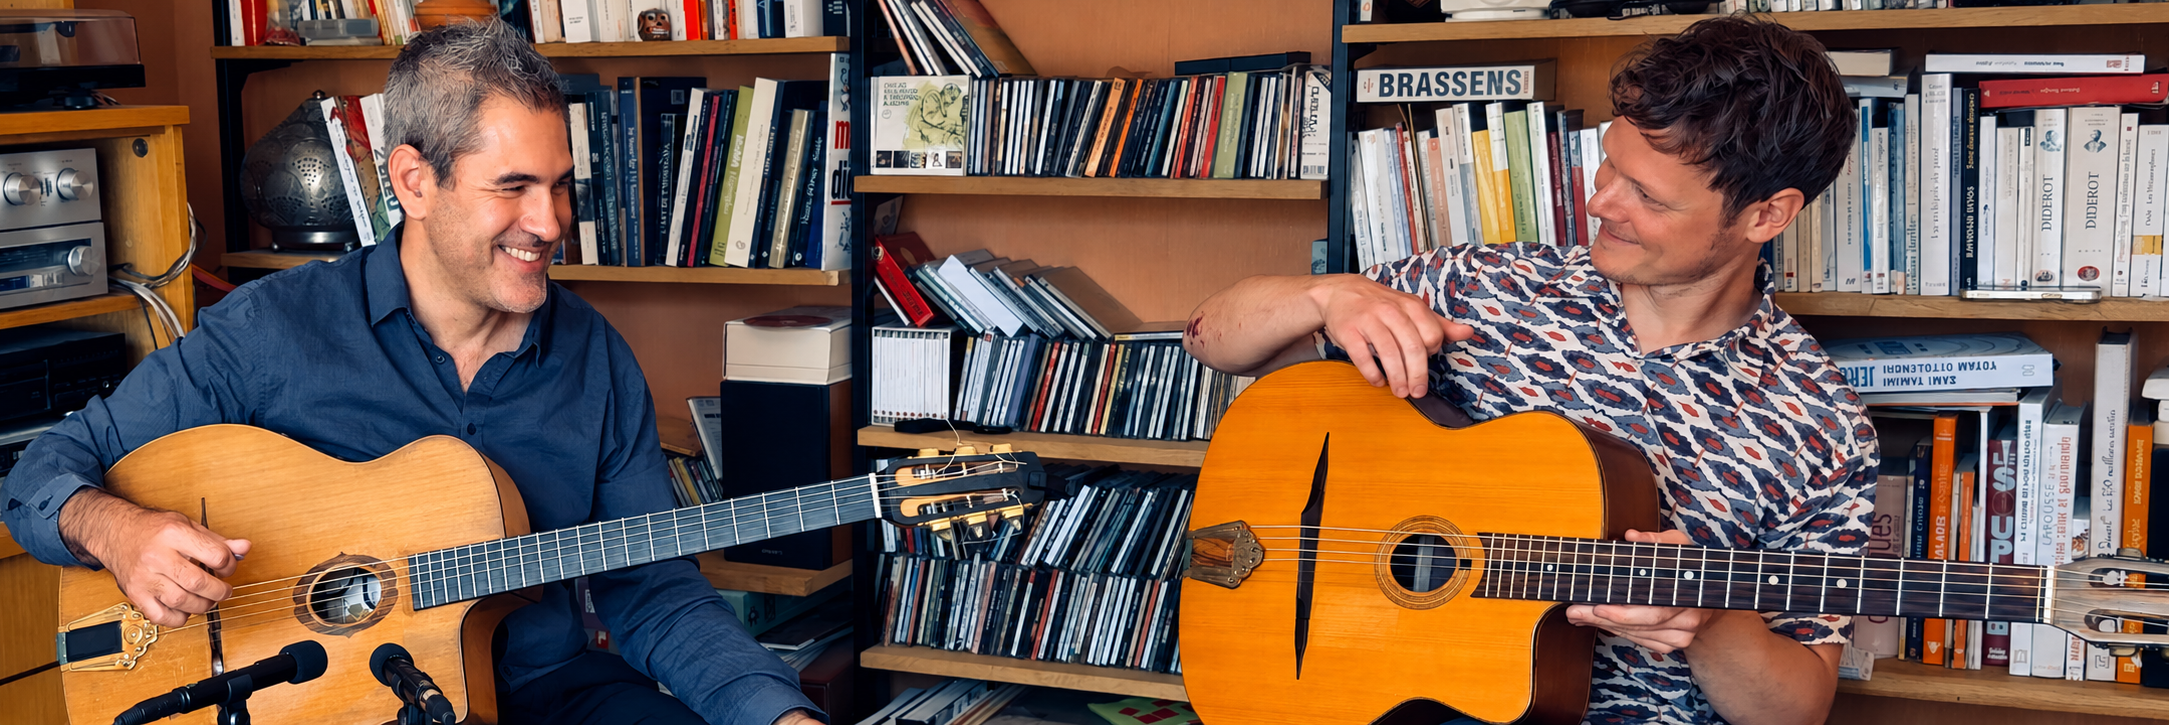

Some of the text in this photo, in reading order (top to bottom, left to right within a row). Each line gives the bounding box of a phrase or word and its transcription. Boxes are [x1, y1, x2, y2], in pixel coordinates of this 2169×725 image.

[1378, 69, 1522, 98] BRASSENS
[2041, 173, 2054, 232] DIDEROT
[2084, 171, 2100, 230] DIDEROT
[1928, 375, 1957, 386] SAMI
